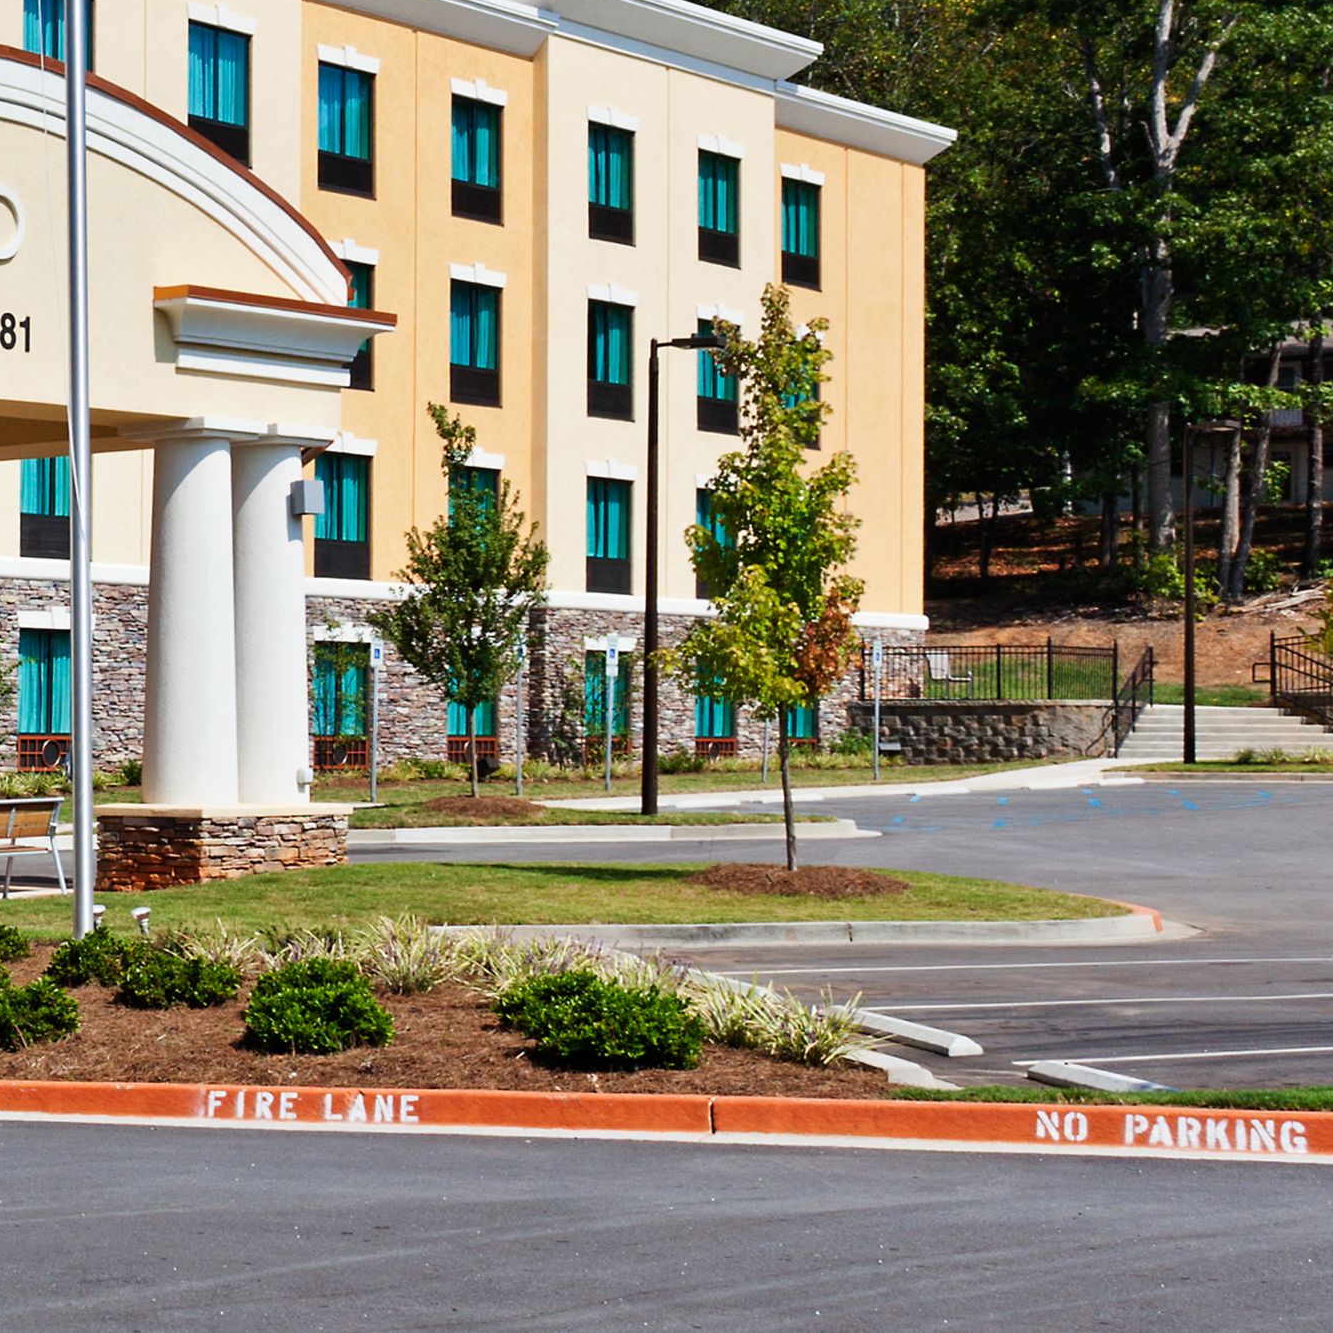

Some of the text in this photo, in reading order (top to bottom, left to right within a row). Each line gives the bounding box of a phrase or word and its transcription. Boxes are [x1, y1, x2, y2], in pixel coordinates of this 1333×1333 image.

[206, 1089, 420, 1123] FIRE LANE
[1035, 1110, 1308, 1154] NO PARKING
